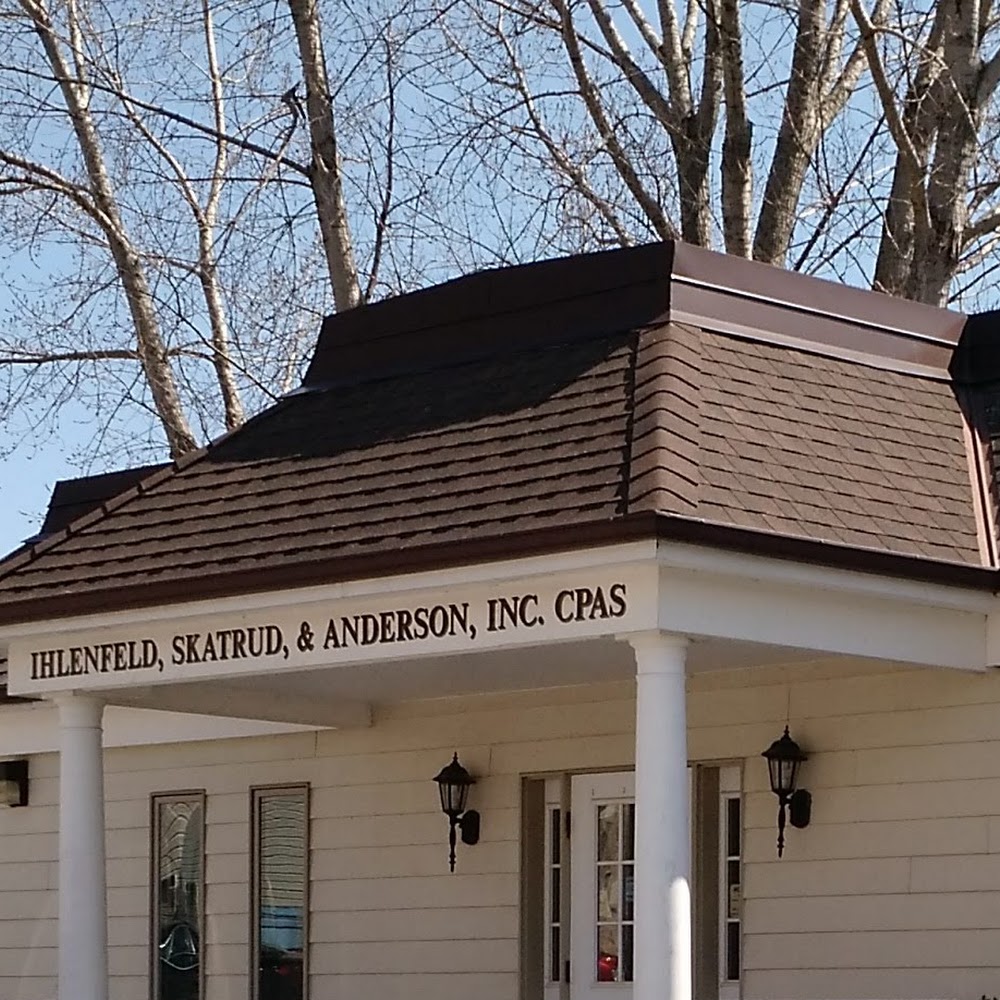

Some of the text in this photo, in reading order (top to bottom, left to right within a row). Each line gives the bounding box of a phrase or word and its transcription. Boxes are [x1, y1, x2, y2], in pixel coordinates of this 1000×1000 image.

[30, 583, 627, 680] IHLENFELD, SKATRUD, & ANDERSON, INC. CPAS
